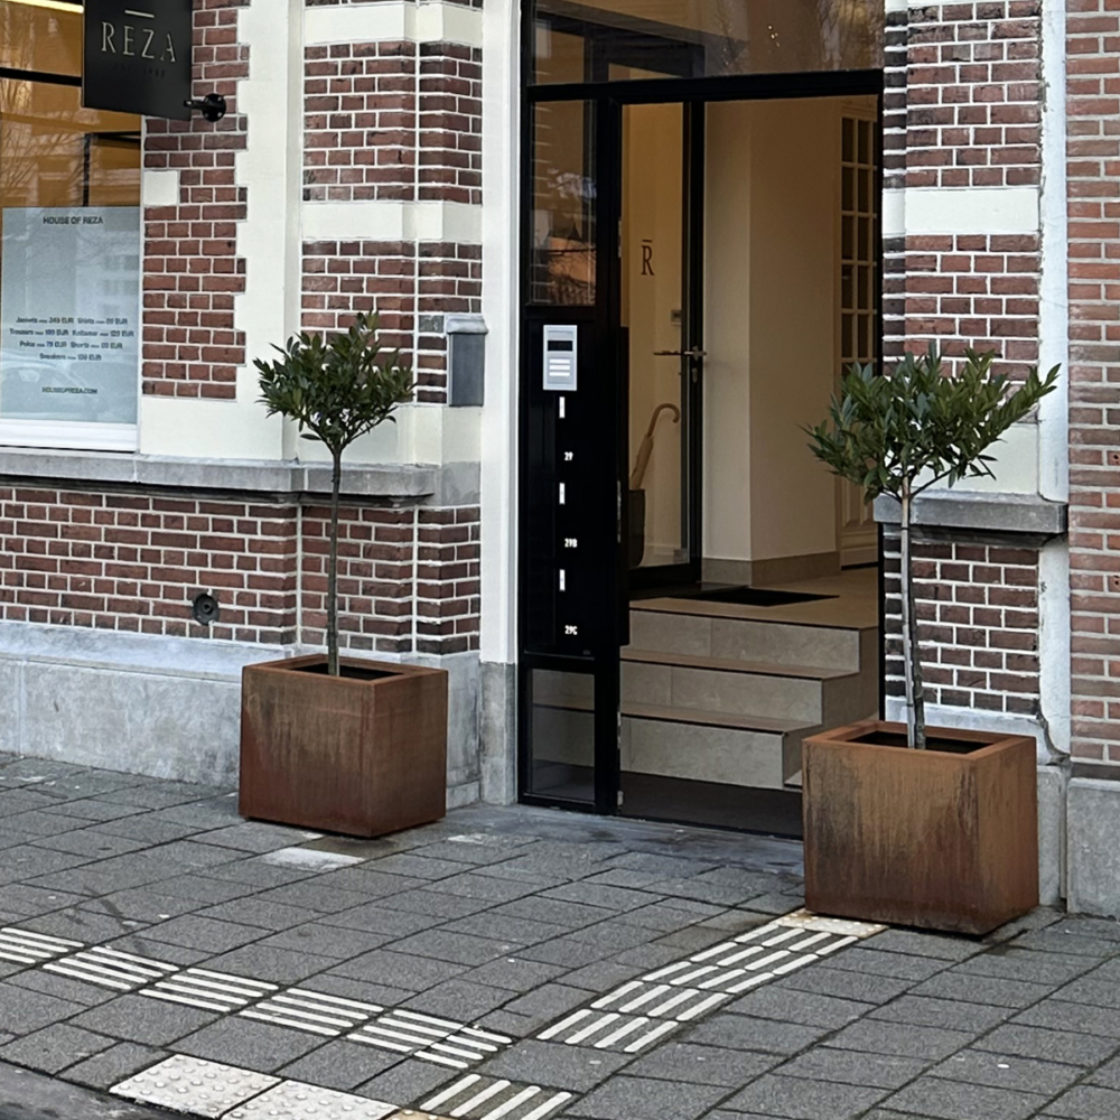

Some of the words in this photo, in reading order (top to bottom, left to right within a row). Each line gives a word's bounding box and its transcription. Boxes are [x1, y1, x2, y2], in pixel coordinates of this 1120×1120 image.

[101, 21, 177, 63] REZA
[42, 216, 69, 224] HOUSE
[70, 216, 82, 224] OF
[82, 216, 104, 224] REZA
